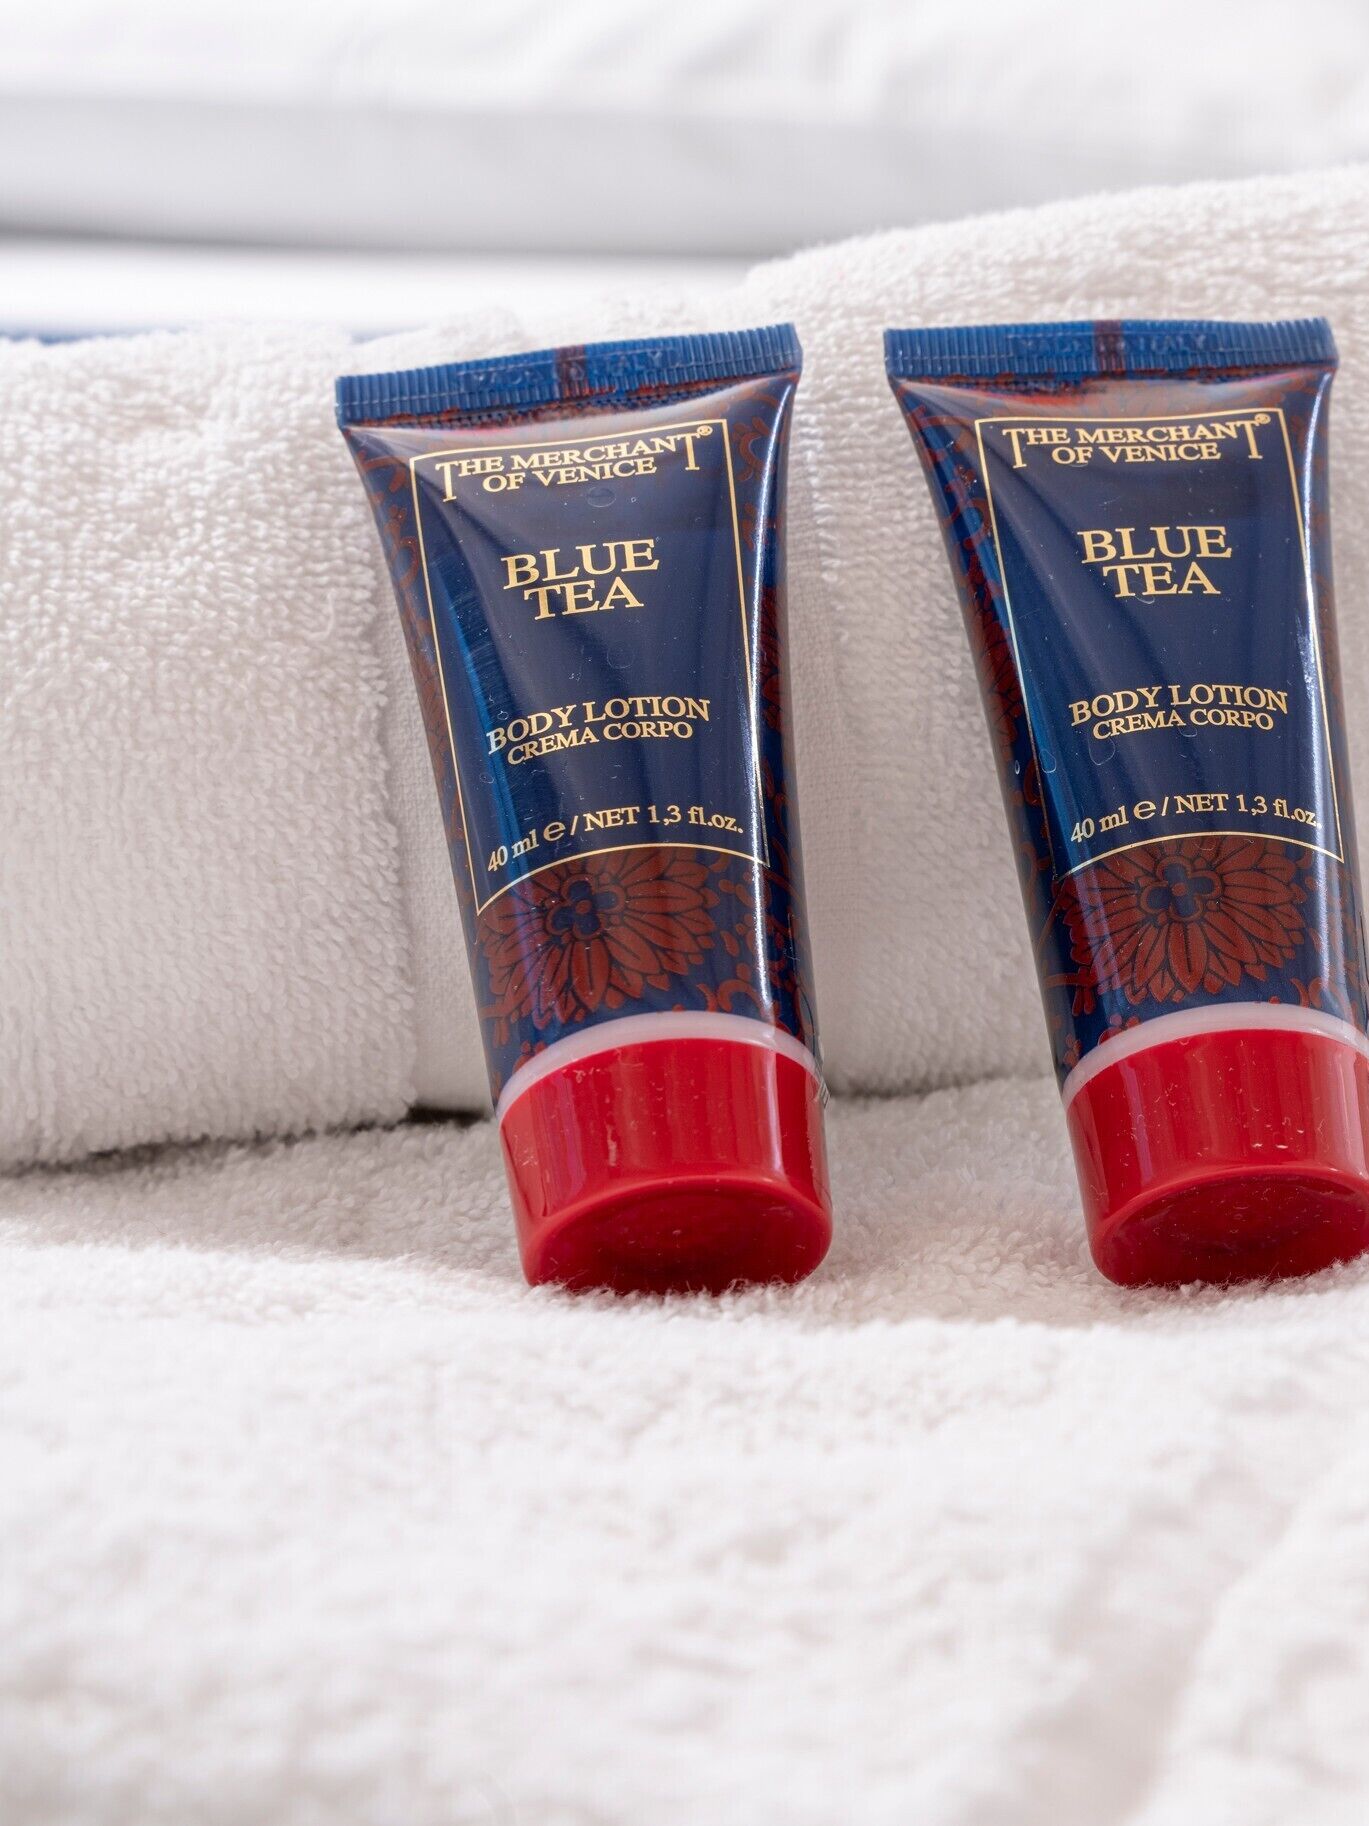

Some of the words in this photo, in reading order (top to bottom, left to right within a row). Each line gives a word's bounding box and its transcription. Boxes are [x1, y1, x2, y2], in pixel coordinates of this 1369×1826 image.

[1002, 428, 1071, 469] THE
[1052, 446, 1094, 465] OF
[1098, 442, 1222, 463] VENICE
[435, 456, 504, 502] THE
[483, 472, 525, 492] OF
[532, 457, 657, 487] VENICE
[500, 538, 660, 589] BLUE
[1077, 526, 1232, 564] BLUE
[524, 576, 644, 621] TEA
[1103, 561, 1221, 598] TEA
[486, 704, 577, 755] BODY
[582, 696, 710, 722] LOTION
[1068, 686, 1162, 727] BODY
[1168, 684, 1288, 715] LOTION
[1092, 709, 1186, 740] CREMA
[1190, 708, 1274, 731] CORPO
[507, 726, 599, 765] CREMA
[603, 721, 693, 740] CORPO
[487, 845, 508, 872] 40
[512, 829, 540, 859] ml
[648, 805, 682, 826] 1,3
[1070, 817, 1095, 843] 40
[1099, 805, 1129, 833] ml
[1236, 794, 1268, 815] 1,3
